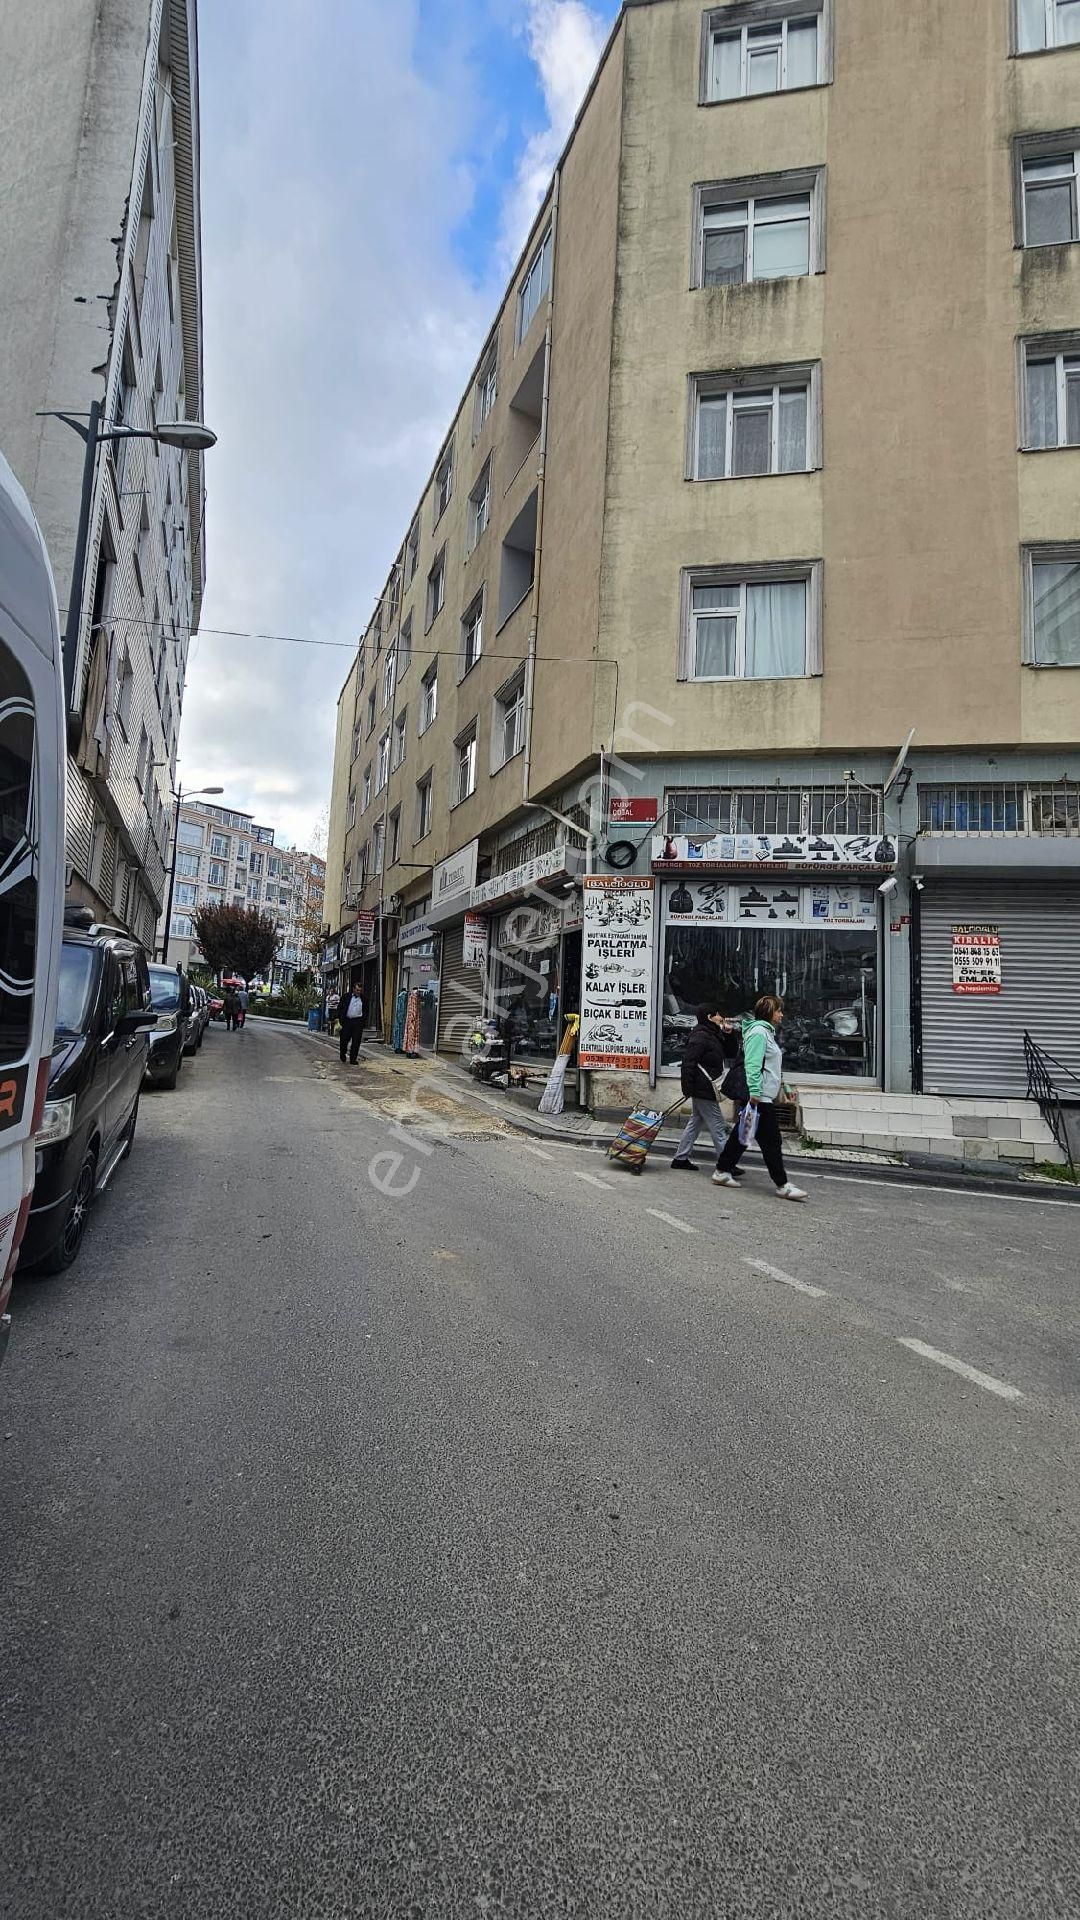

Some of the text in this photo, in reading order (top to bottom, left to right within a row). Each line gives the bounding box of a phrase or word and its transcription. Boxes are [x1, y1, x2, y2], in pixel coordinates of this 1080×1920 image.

[588, 940, 647, 949] PARLATMA
[599, 948, 635, 960] İŞLERİ
[954, 957, 970, 965] 0555
[586, 982, 616, 993] KALAY
[584, 1009, 612, 1020] BIÇAK
